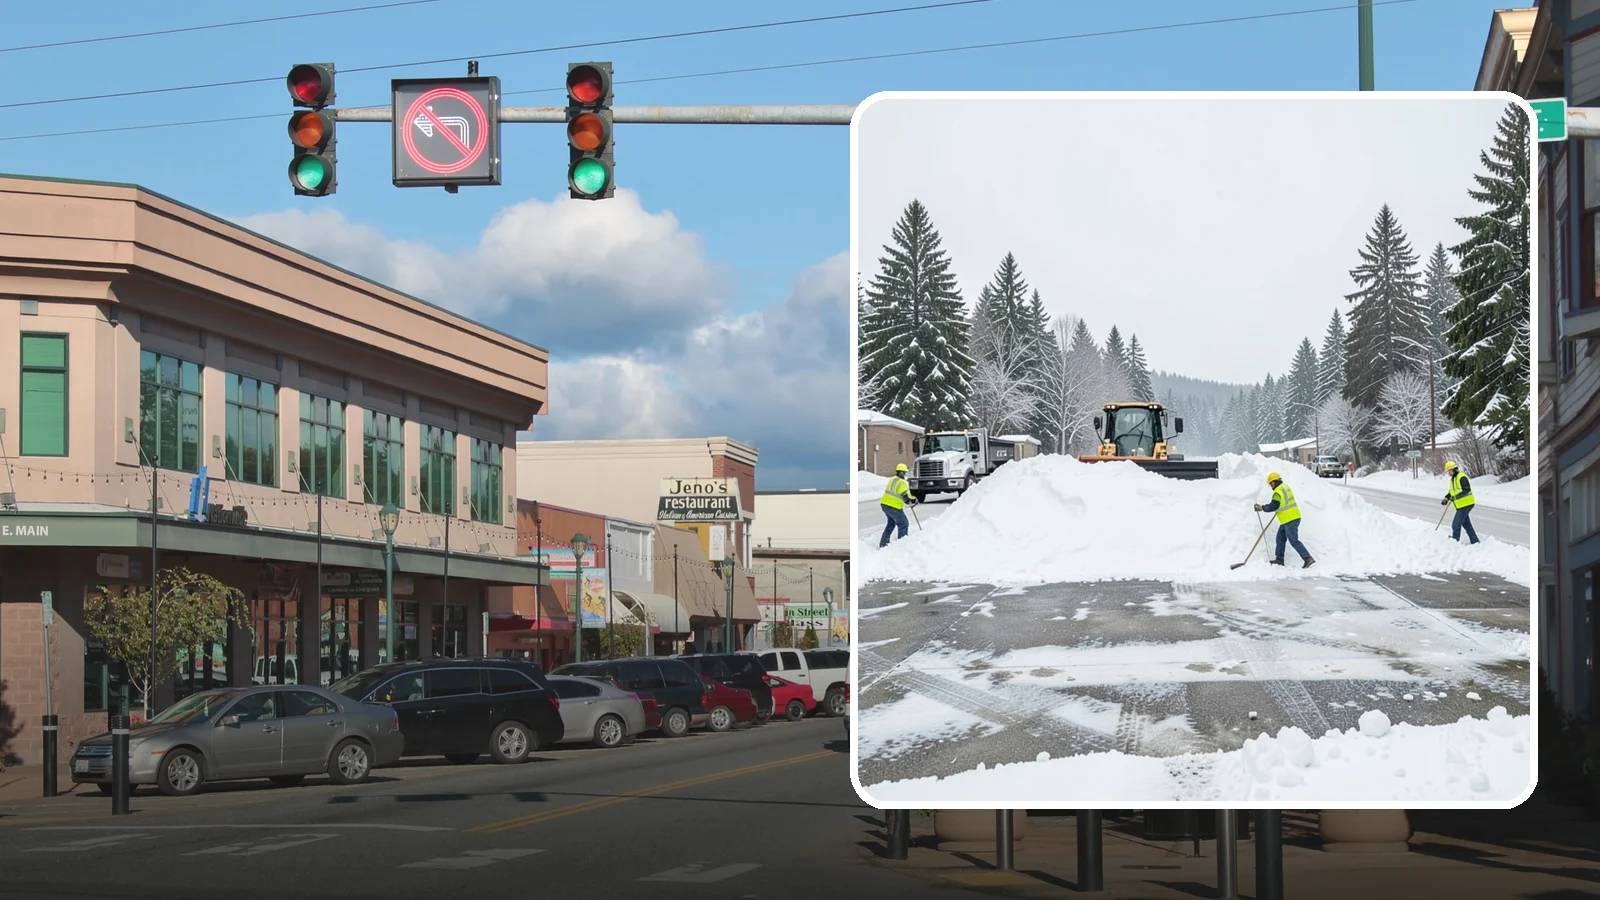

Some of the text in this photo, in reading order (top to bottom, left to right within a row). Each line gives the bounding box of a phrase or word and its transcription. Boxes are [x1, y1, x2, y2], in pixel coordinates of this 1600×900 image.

[670, 480, 727, 494] Jeno's
[665, 496, 731, 509] restaurant
[659, 509, 681, 519] Italian
[686, 510, 714, 519] American
[715, 509, 737, 519] Cuisine
[2, 525, 49, 536] E. MAIN
[797, 607, 828, 616] Street
